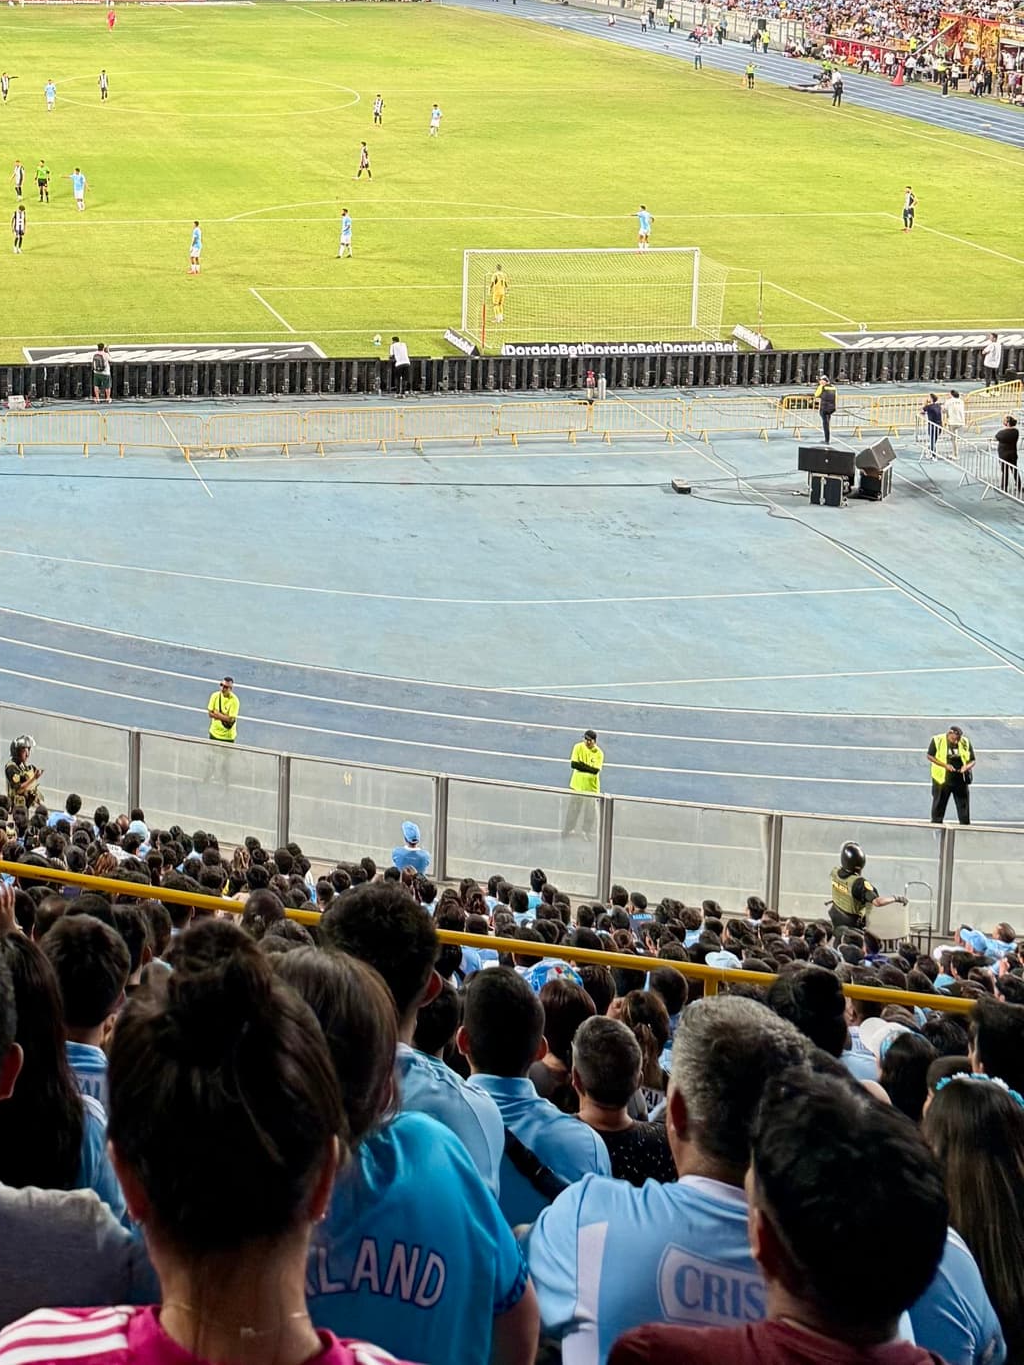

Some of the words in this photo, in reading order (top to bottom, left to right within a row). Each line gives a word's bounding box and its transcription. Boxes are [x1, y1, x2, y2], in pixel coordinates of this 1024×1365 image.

[505, 344, 584, 355] DoradoBet
[584, 343, 661, 355] DoradoBet
[664, 341, 739, 353] DoradoBet
[306, 1236, 447, 1309] LAND
